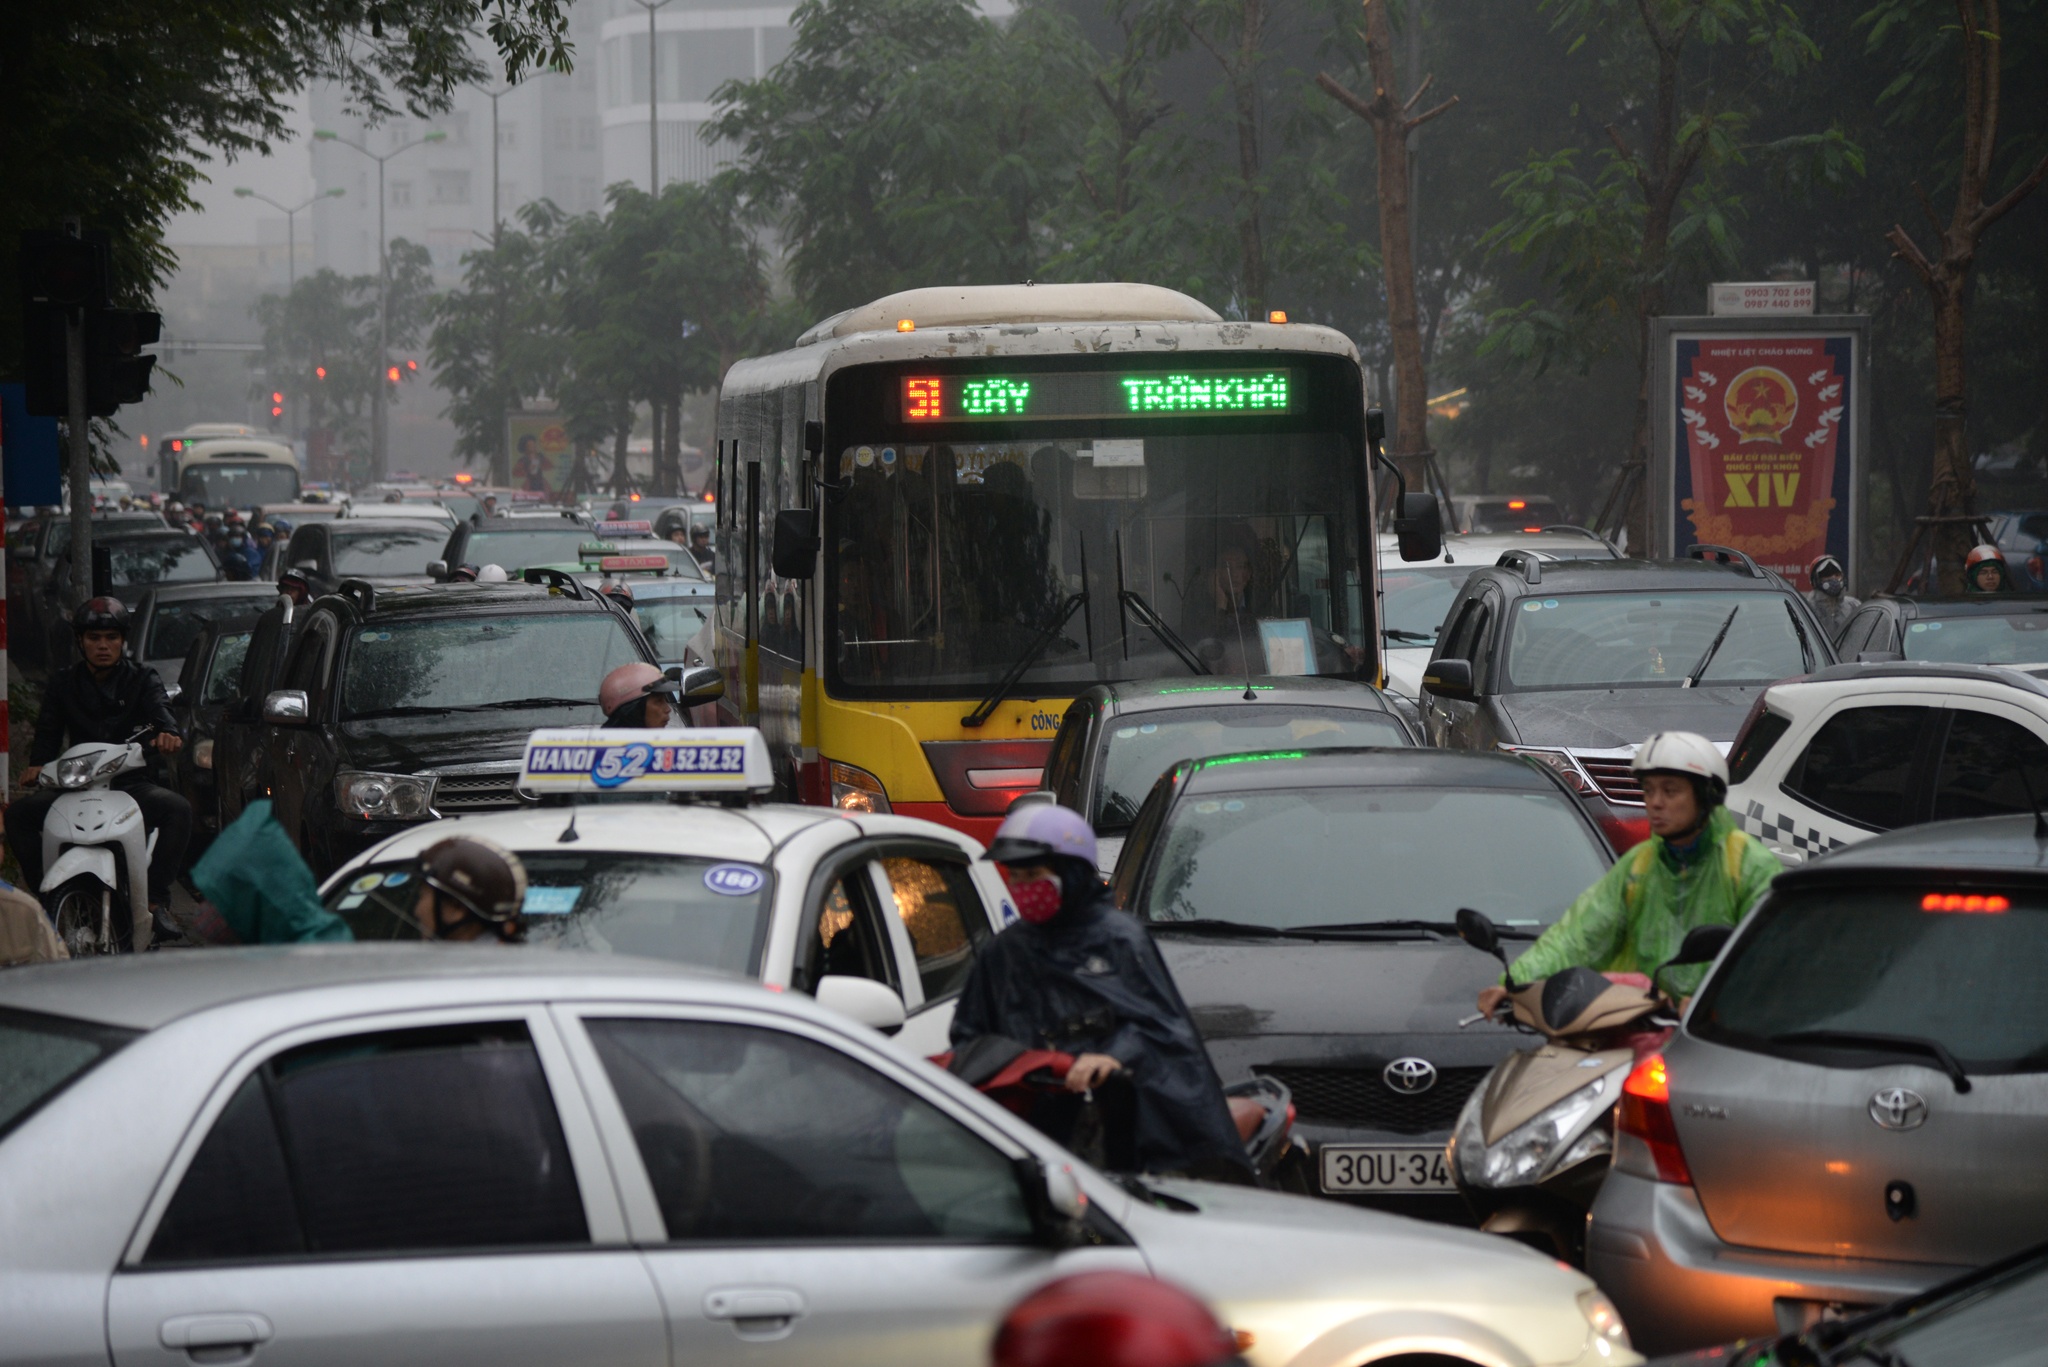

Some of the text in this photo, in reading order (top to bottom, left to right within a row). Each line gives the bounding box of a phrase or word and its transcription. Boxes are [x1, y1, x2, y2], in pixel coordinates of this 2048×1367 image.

[1744, 288, 1812, 297] 0903 702 689
[1744, 300, 1769, 309] 0987
[1772, 299, 1790, 308] 440
[1724, 472, 1800, 507] XIV
[595, 745, 650, 780] 52
[1336, 1154, 1449, 1185] 30U-34
